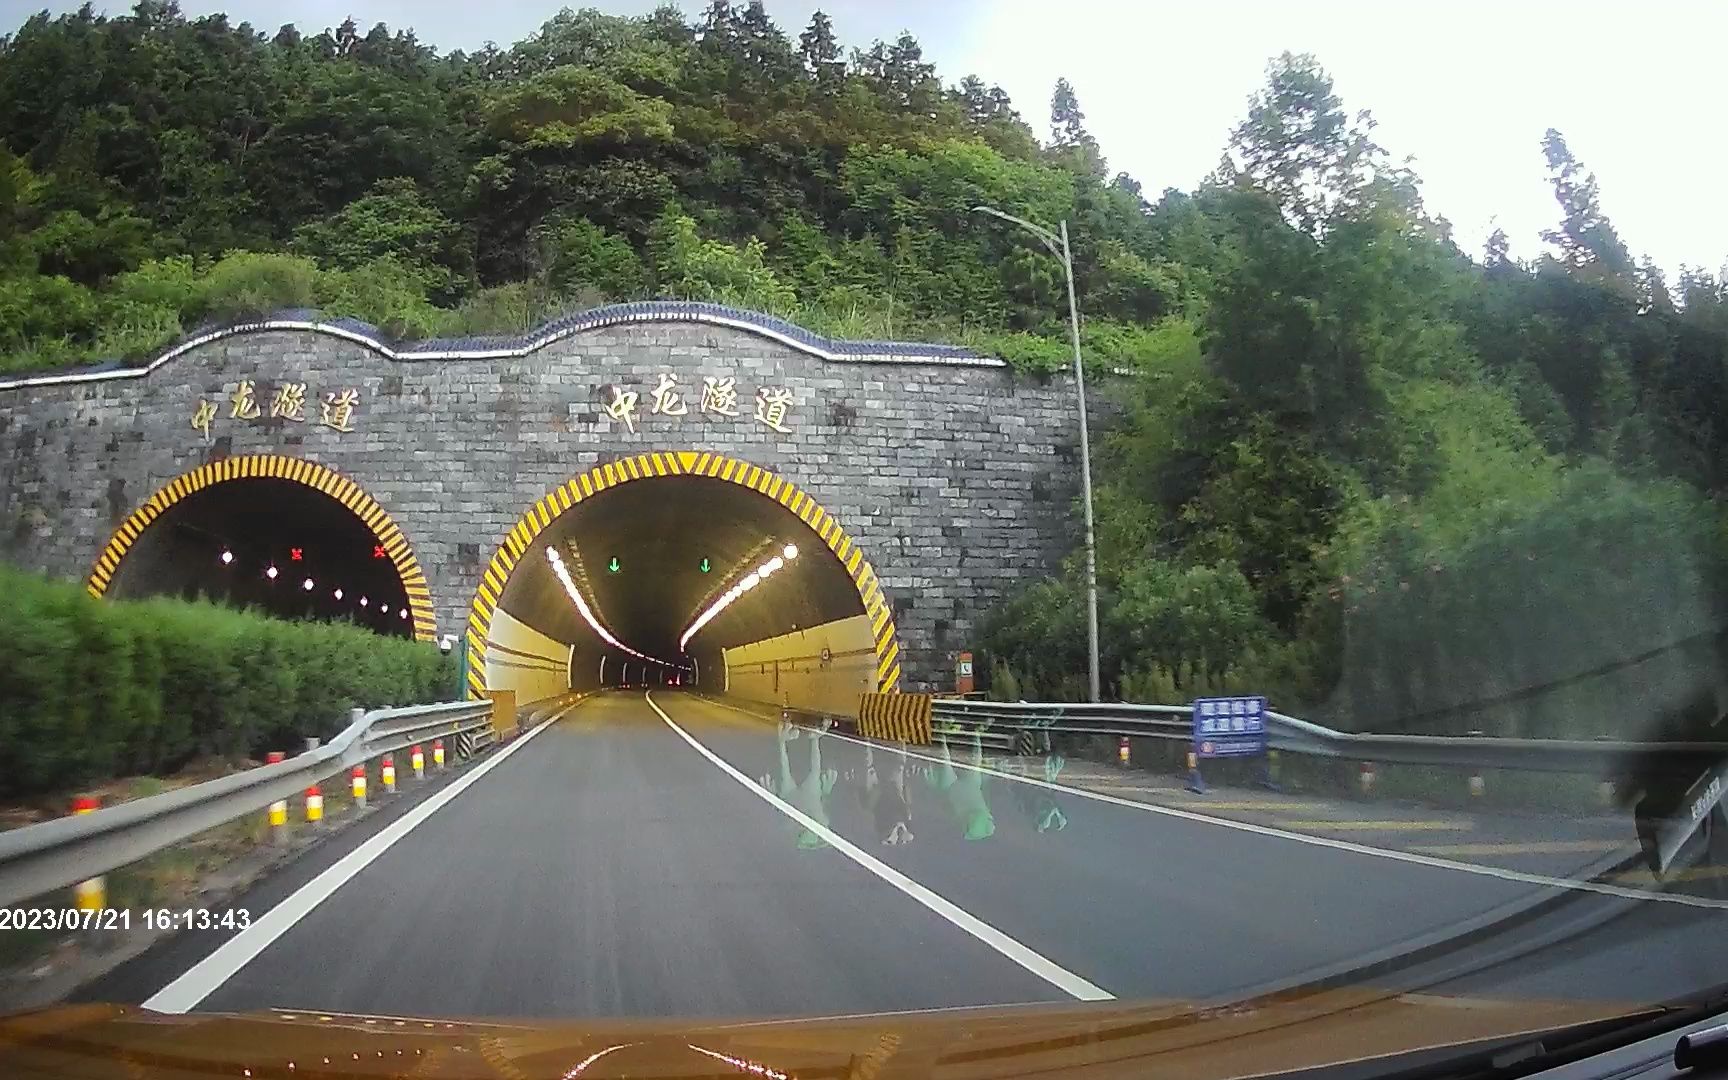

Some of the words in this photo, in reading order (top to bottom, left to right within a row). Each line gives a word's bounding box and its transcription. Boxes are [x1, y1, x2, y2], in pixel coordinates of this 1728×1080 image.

[191, 379, 360, 442] 中龙隧道
[604, 373, 794, 434] 中龙隧道
